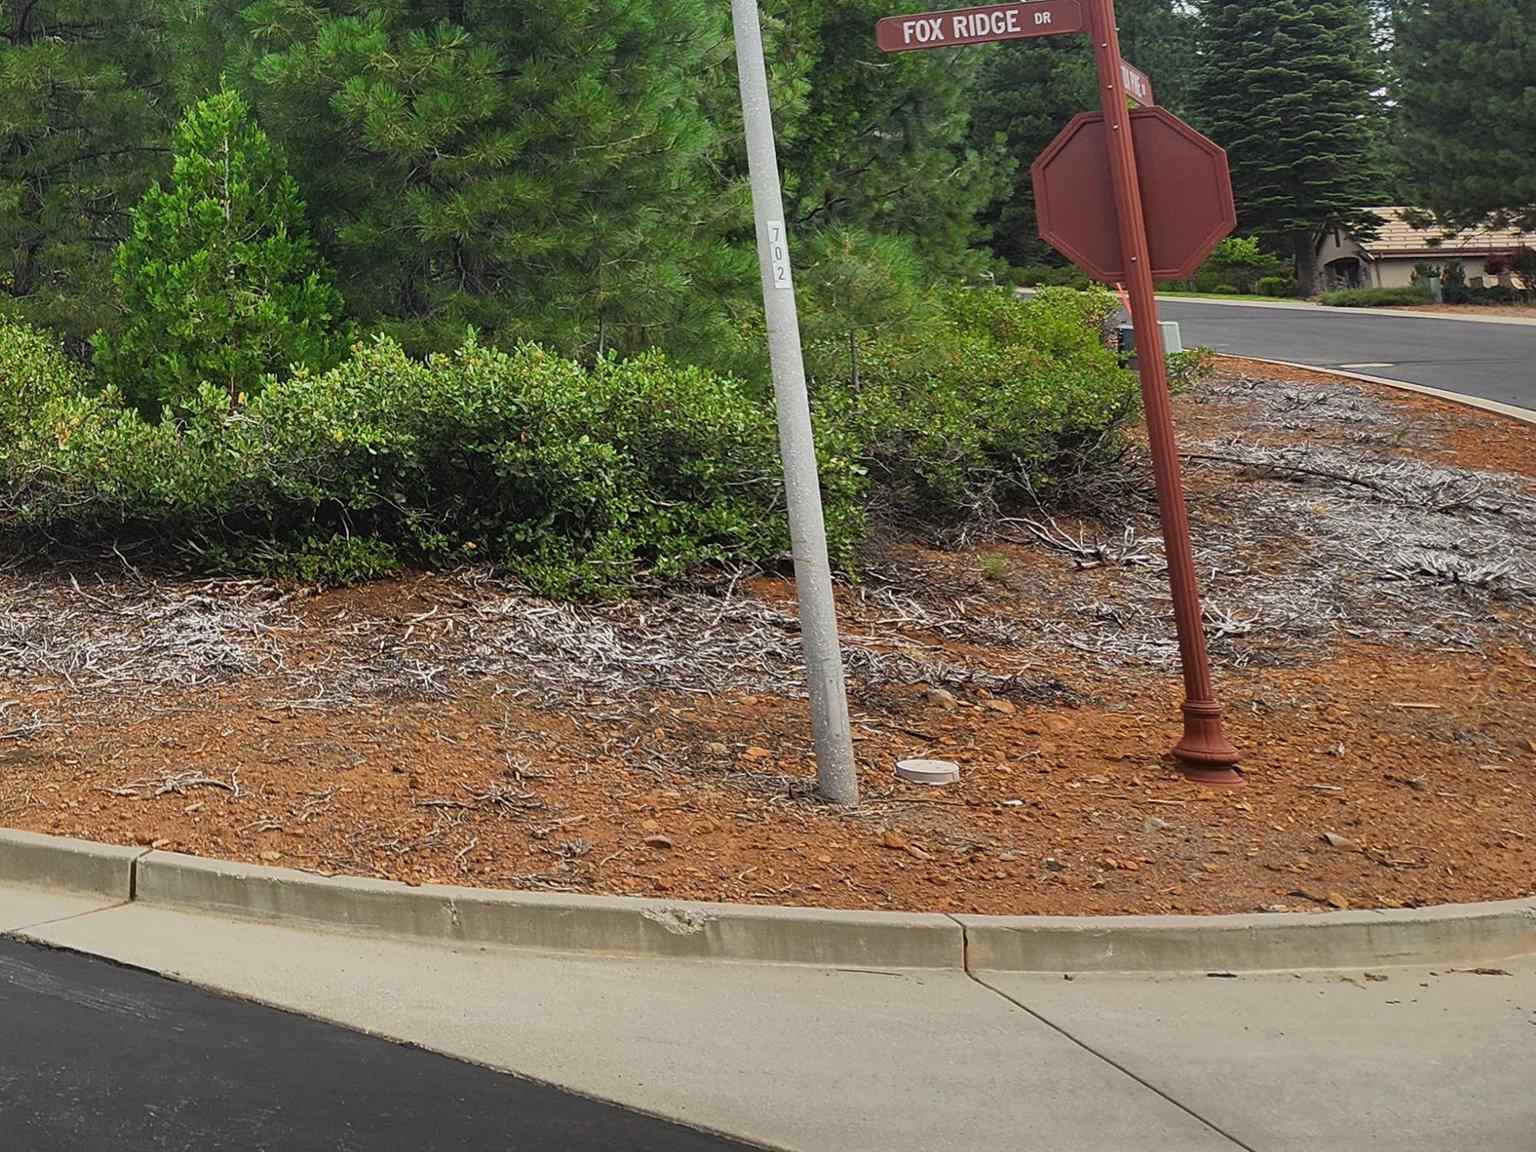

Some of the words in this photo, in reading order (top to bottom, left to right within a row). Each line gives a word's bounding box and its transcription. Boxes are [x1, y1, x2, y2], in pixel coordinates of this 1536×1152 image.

[902, 17, 945, 44] FOX
[952, 9, 1021, 39] RIDGE
[1034, 11, 1052, 25] DR
[772, 227, 785, 281] 702
